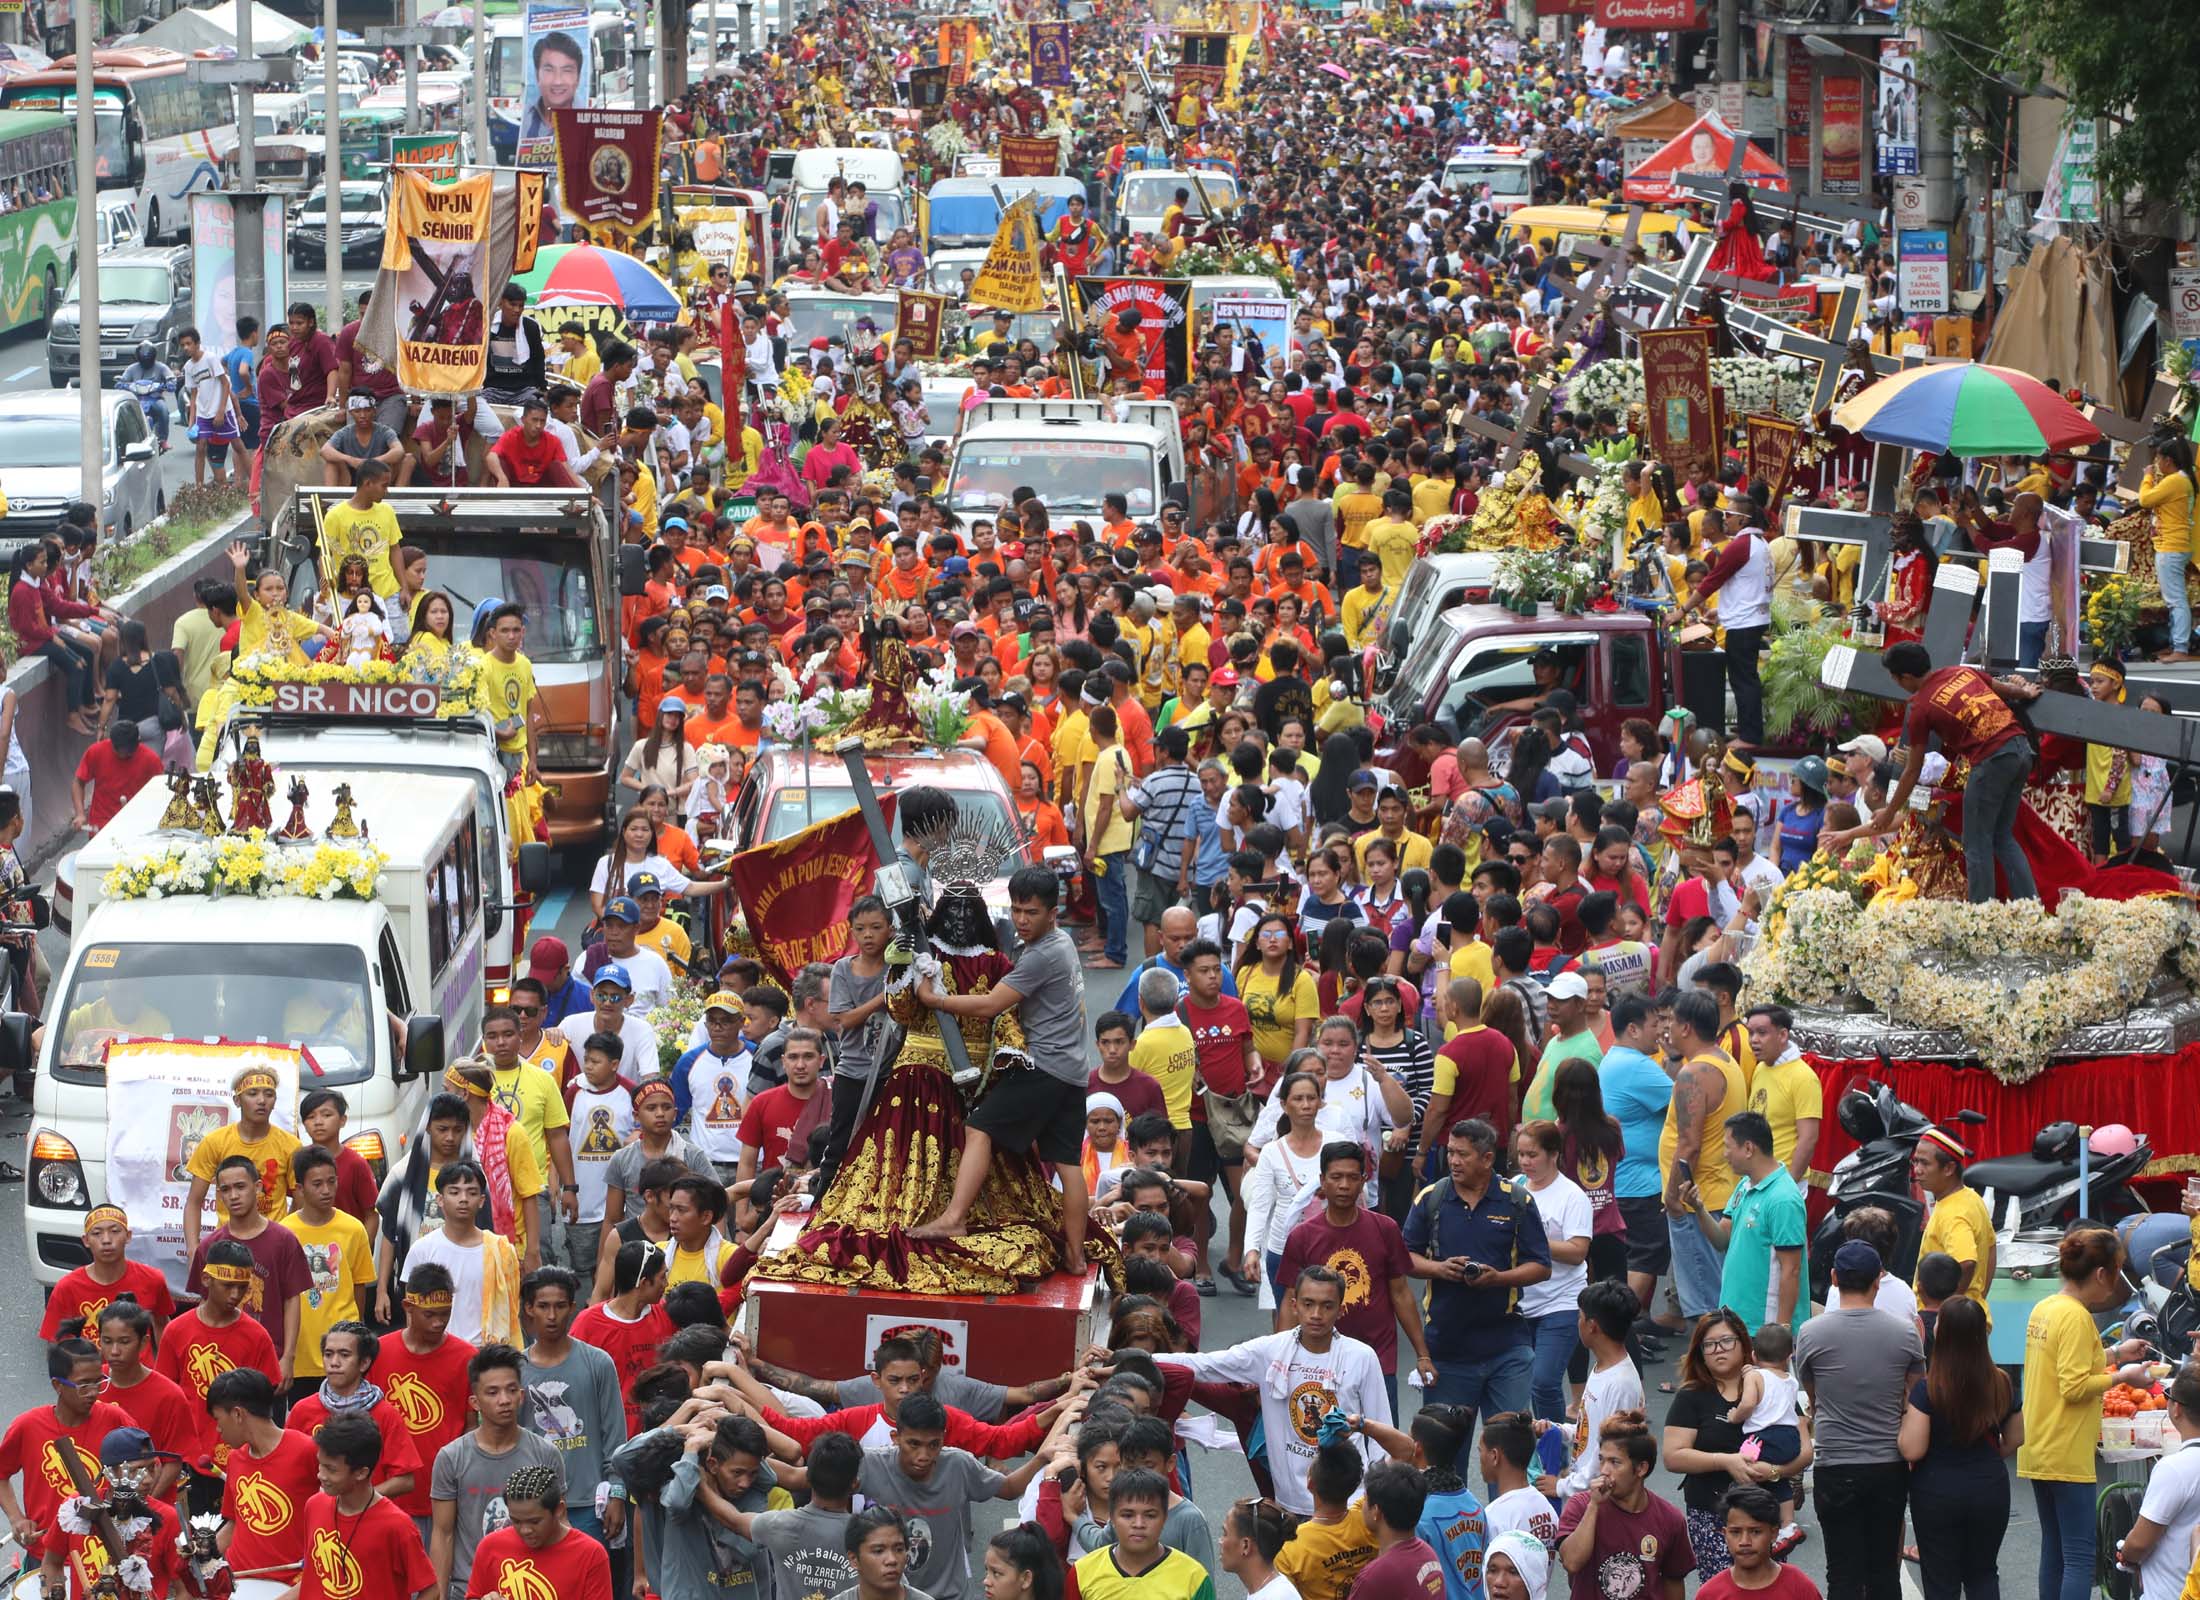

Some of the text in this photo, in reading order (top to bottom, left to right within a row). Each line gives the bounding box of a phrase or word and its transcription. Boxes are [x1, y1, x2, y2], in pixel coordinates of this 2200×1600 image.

[1606, 3, 1675, 19] Chowking
[426, 192, 472, 212] NPJN
[524, 187, 538, 253] VIVA
[422, 221, 474, 240] SENIOR
[1217, 304, 1285, 318] JESUS NAZARENO
[1910, 299, 1941, 308] MTPB
[408, 345, 479, 366] NAZARENO
[727, 506, 758, 519] CADA
[279, 685, 436, 714] SR. NICO
[1167, 1057, 1194, 1073] CHAPTE
[162, 1195, 184, 1209] SR.
[1303, 1372, 1325, 1381] 2018
[1286, 1443, 1315, 1458] NAZAR
[1529, 1512, 1551, 1530] HDN
[796, 1564, 846, 1580] APO ZARETH
[803, 1576, 836, 1590] CHAPTER
